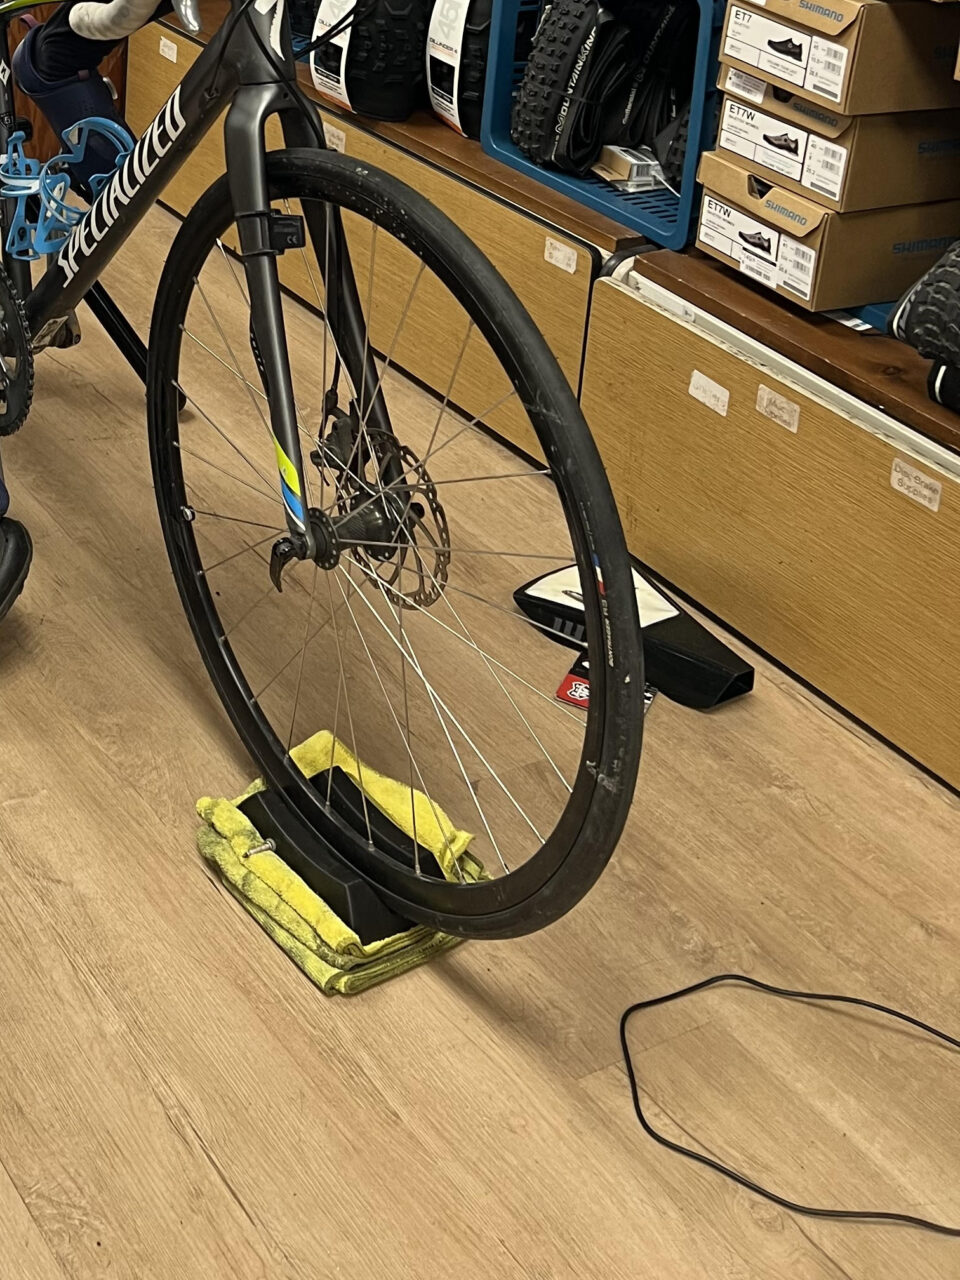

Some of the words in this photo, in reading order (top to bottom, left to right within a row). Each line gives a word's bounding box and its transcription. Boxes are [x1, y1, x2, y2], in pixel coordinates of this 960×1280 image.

[734, 9, 752, 23] ET7
[799, 0, 844, 23] SHIMANO
[729, 103, 756, 121] ET7W
[792, 102, 839, 128] SHIMANO
[57, 84, 187, 289] SPECIALIZED
[707, 199, 732, 219] ET7W
[764, 199, 808, 227] SHIMANO
[896, 476, 934, 505] Supplies
